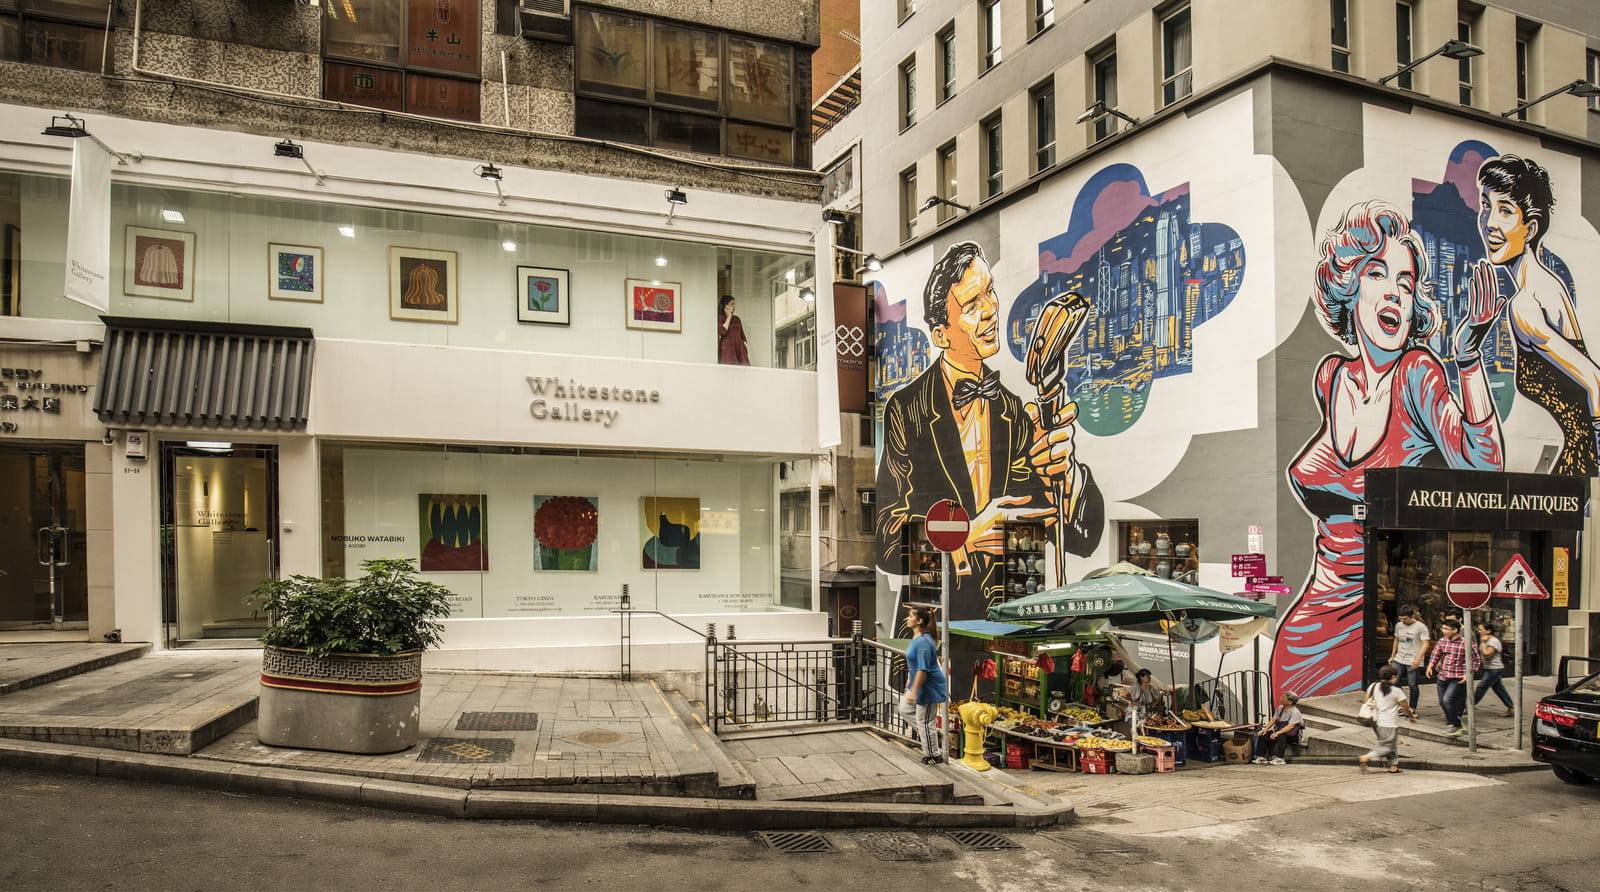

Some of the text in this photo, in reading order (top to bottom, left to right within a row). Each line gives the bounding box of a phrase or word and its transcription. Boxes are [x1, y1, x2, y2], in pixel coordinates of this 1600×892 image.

[736, 131, 781, 154] 中心
[71, 267, 93, 285] Gallery
[525, 376, 660, 403] Whitestone
[529, 399, 619, 428] Gallery
[1408, 490, 1579, 515] ARCH ANGEL ANTIQUES
[367, 535, 405, 543] WATABIKI
